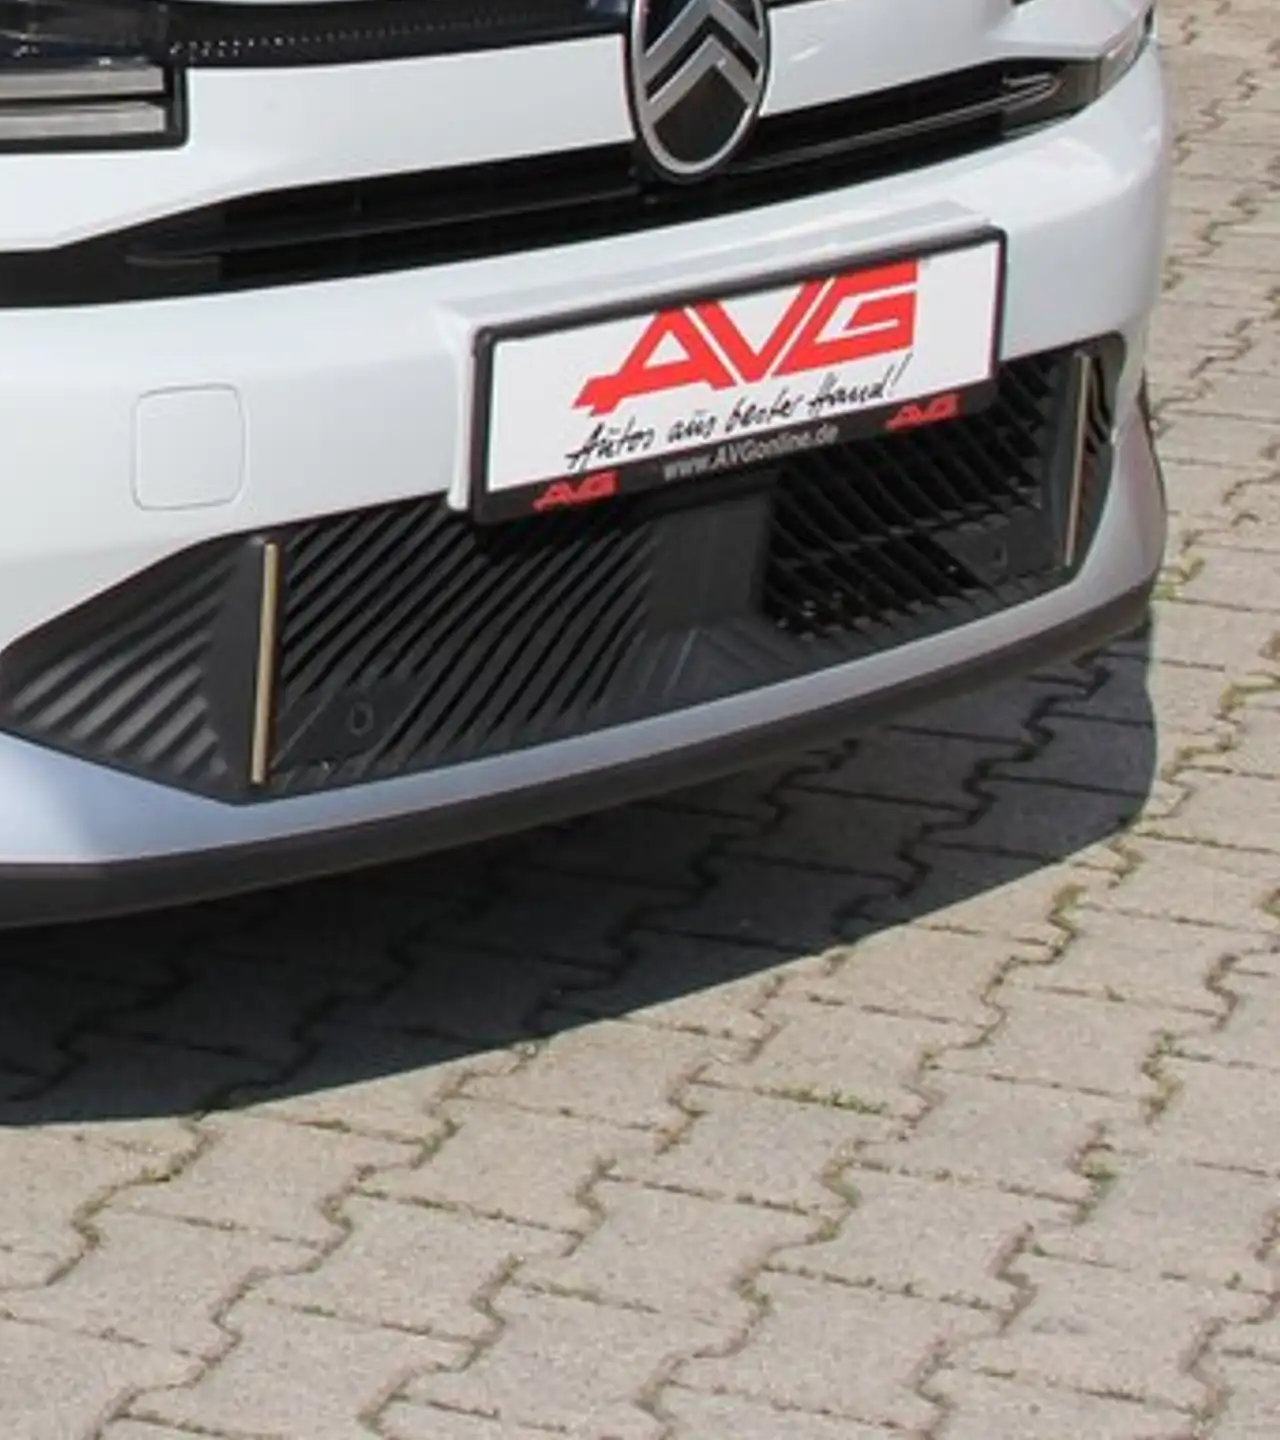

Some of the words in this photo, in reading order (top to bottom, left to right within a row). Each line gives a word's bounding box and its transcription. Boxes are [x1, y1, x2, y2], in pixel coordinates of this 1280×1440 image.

[572, 260, 918, 417] AVG
[886, 393, 960, 431] AVG
[663, 423, 839, 482] www.AVGonline.de
[532, 471, 618, 511] AVG
